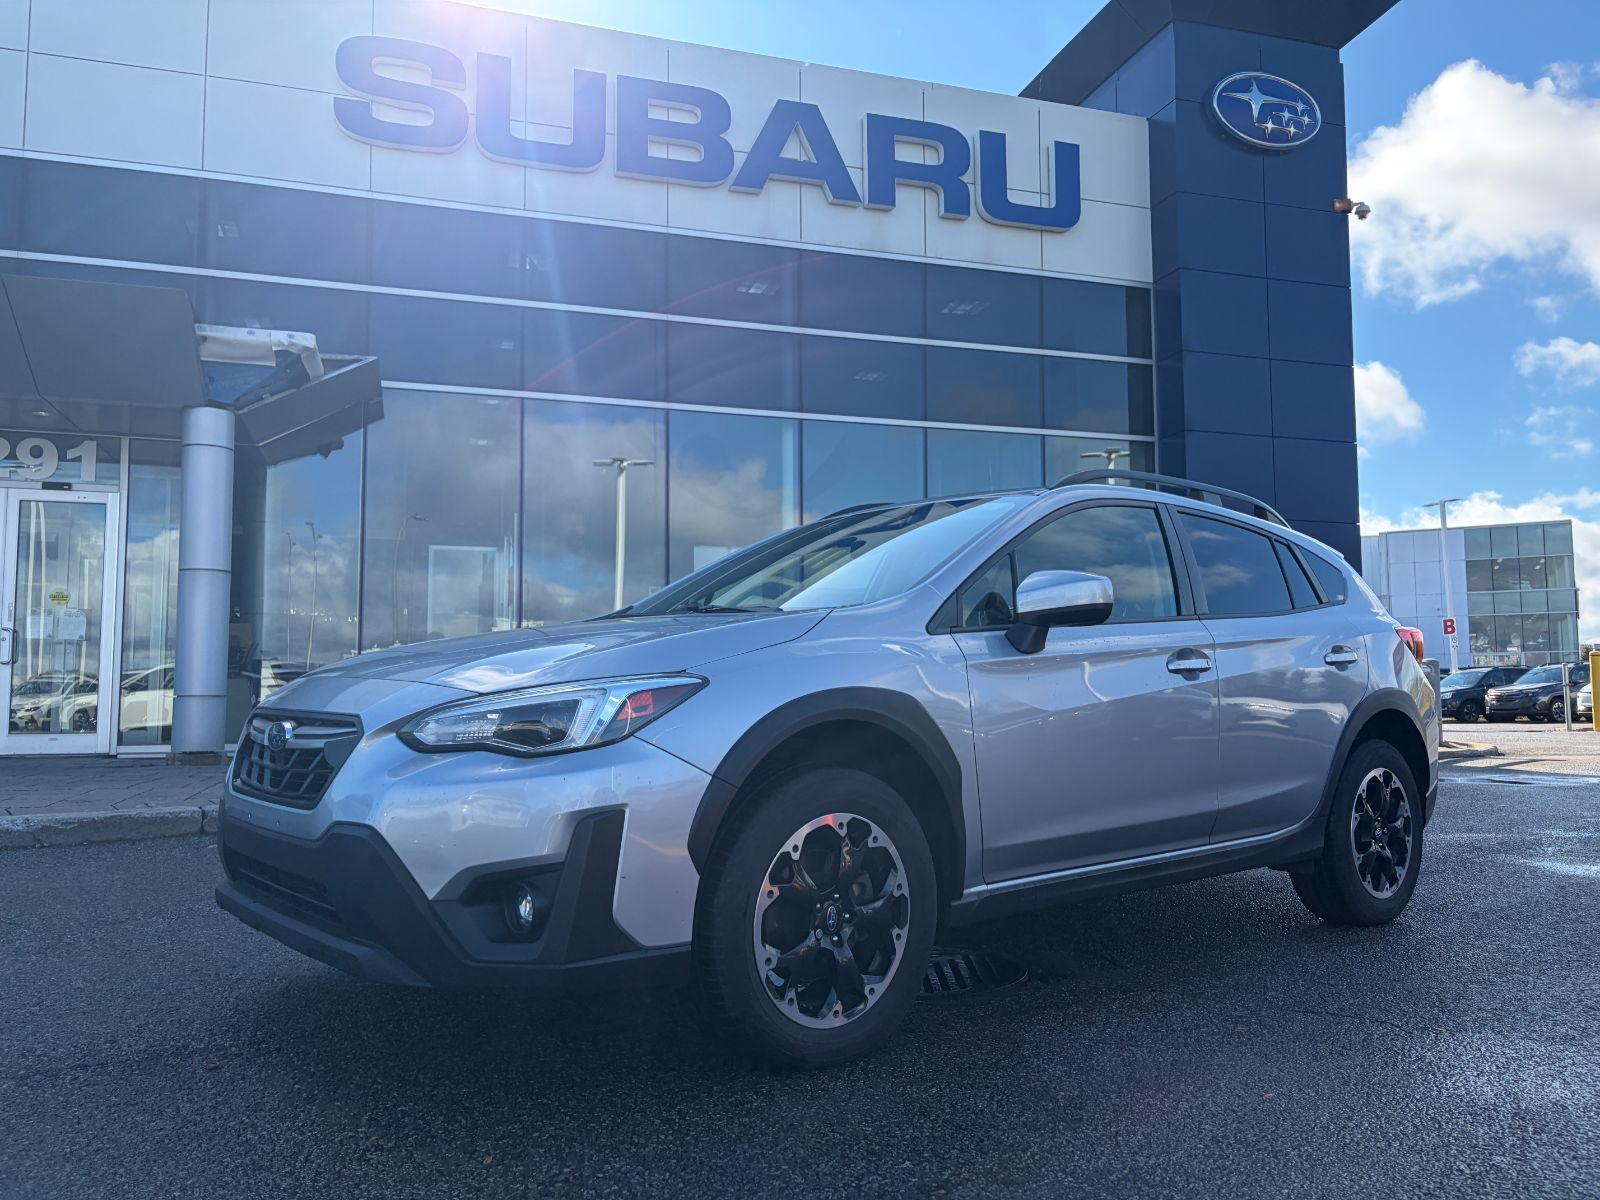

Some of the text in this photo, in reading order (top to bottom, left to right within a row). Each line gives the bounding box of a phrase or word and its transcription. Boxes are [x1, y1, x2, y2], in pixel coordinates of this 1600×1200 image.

[334, 36, 1081, 232] SUBARU
[0, 437, 97, 482] 91
[1443, 619, 1456, 635] B
